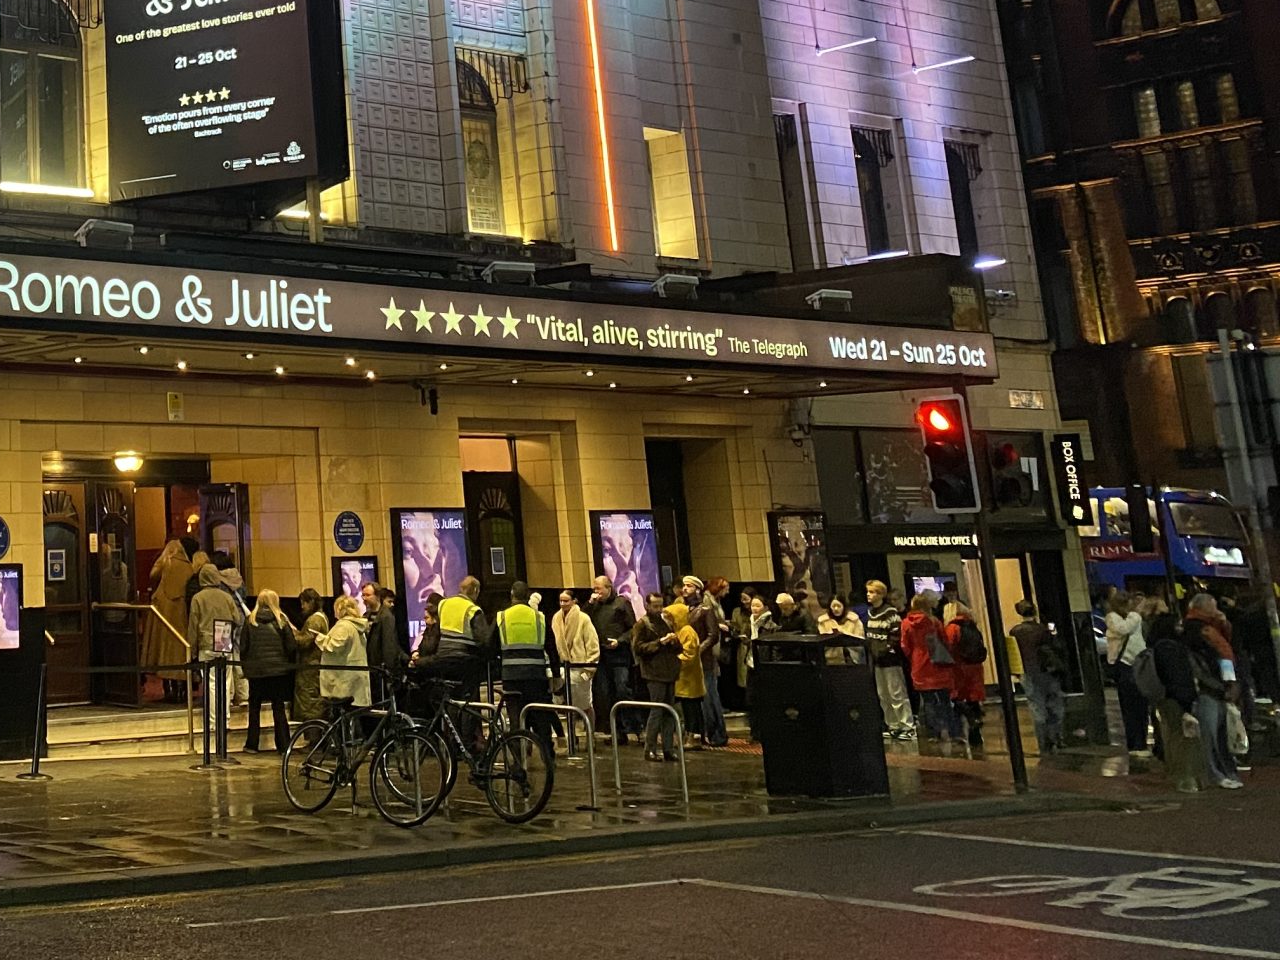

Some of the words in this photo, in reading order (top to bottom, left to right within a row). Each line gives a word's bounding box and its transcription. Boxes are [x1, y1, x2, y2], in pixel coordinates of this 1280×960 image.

[115, 33, 134, 44] One
[135, 30, 146, 41] of
[146, 27, 162, 39] the
[162, 21, 200, 37] greatest
[201, 17, 220, 29] love
[221, 11, 253, 25] stories
[255, 7, 276, 18] ever
[276, 1, 296, 14] told
[174, 56, 188, 70] 21
[197, 52, 214, 67] 25
[214, 48, 237, 63] Oct
[178, 108, 202, 121] pours
[202, 105, 222, 116] from
[222, 102, 247, 113] every
[247, 97, 276, 109] corner
[148, 125, 158, 135] of
[157, 123, 172, 133] the
[172, 120, 194, 131] often
[195, 112, 242, 128] overflowing
[175, 274, 213, 324] &
[224, 278, 333, 333] Juliet
[526, 313, 589, 347] "Vital,
[592, 319, 644, 351] alive,
[646, 323, 723, 357] stirring"
[727, 337, 751, 354] The
[752, 338, 808, 361] Telegraph
[829, 335, 868, 360] Wed
[870, 339, 887, 362] 21
[902, 341, 935, 365] Sun
[936, 343, 957, 366] 25
[959, 344, 987, 368] Oct
[1062, 441, 1074, 463] BOX
[1065, 464, 1081, 500] OFFICE
[441, 517, 463, 529] Juliet
[635, 518, 653, 529] Juliet
[893, 536, 915, 546] PALACE
[915, 536, 938, 546] THEATRE
[938, 536, 951, 546] BOX
[951, 536, 971, 546] OFFICE
[1090, 544, 1134, 556] RIMM
